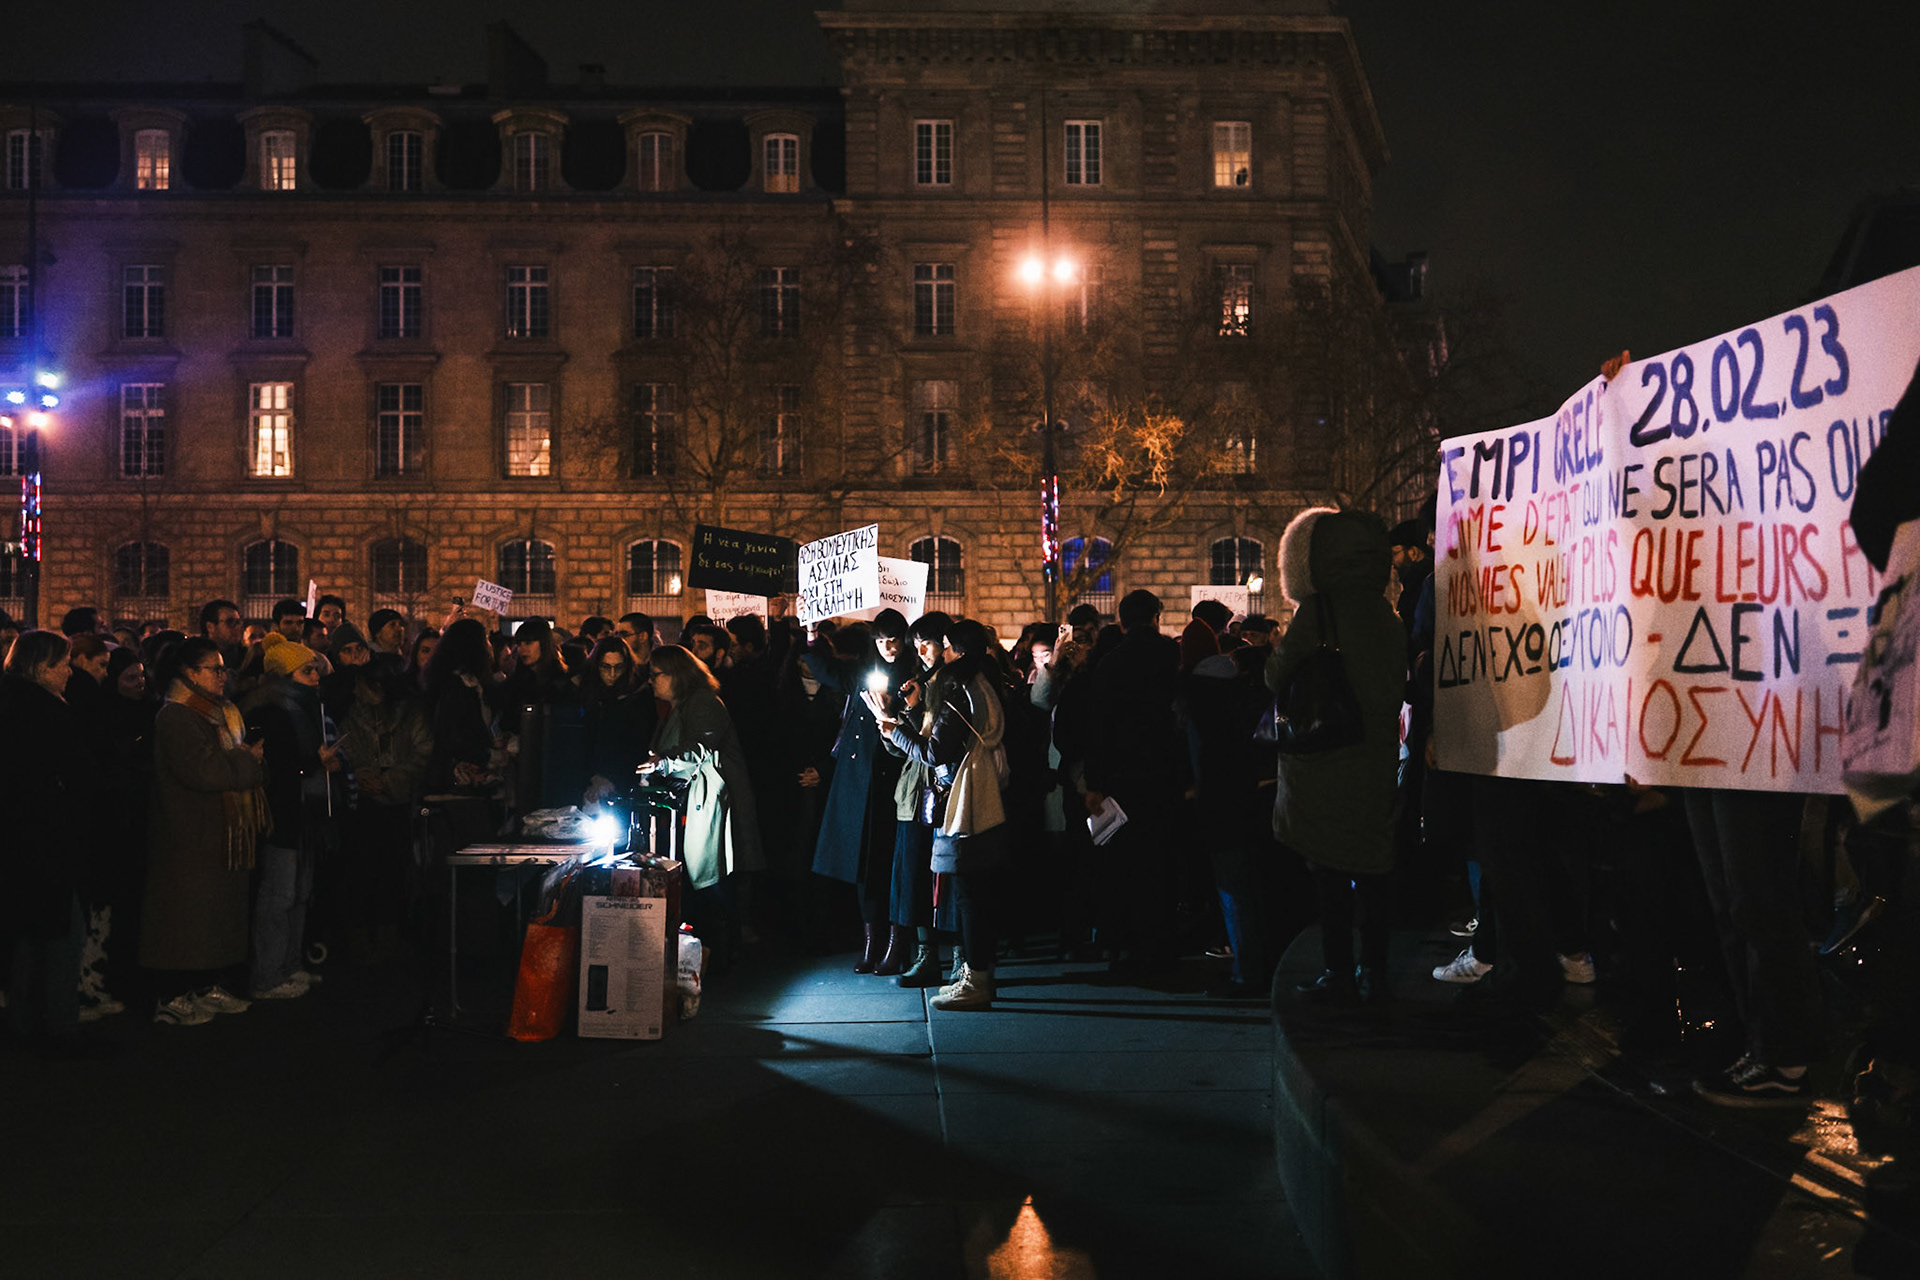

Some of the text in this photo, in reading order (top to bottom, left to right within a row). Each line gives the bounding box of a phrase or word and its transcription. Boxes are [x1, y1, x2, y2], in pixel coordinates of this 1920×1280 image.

[1441, 430, 1541, 506] EMPI
[1630, 303, 1850, 448] 28.02.23
[1607, 463, 1645, 521] NE
[1651, 447, 1745, 521] SERA
[1756, 431, 1817, 514] PAS
[479, 581, 512, 600] JUSTICE
[808, 551, 860, 585] ΑΣΥΛΙΑΣ
[823, 578, 843, 598] ΣΤΗ
[1581, 527, 1618, 604] PLUS
[1630, 526, 1705, 605] QUE
[1715, 522, 1829, 607] LEURS
[1673, 603, 1800, 682] ΔΕΝ
[1550, 677, 1845, 779] ΔΙΚΑΙΟΣΥΝΗ
